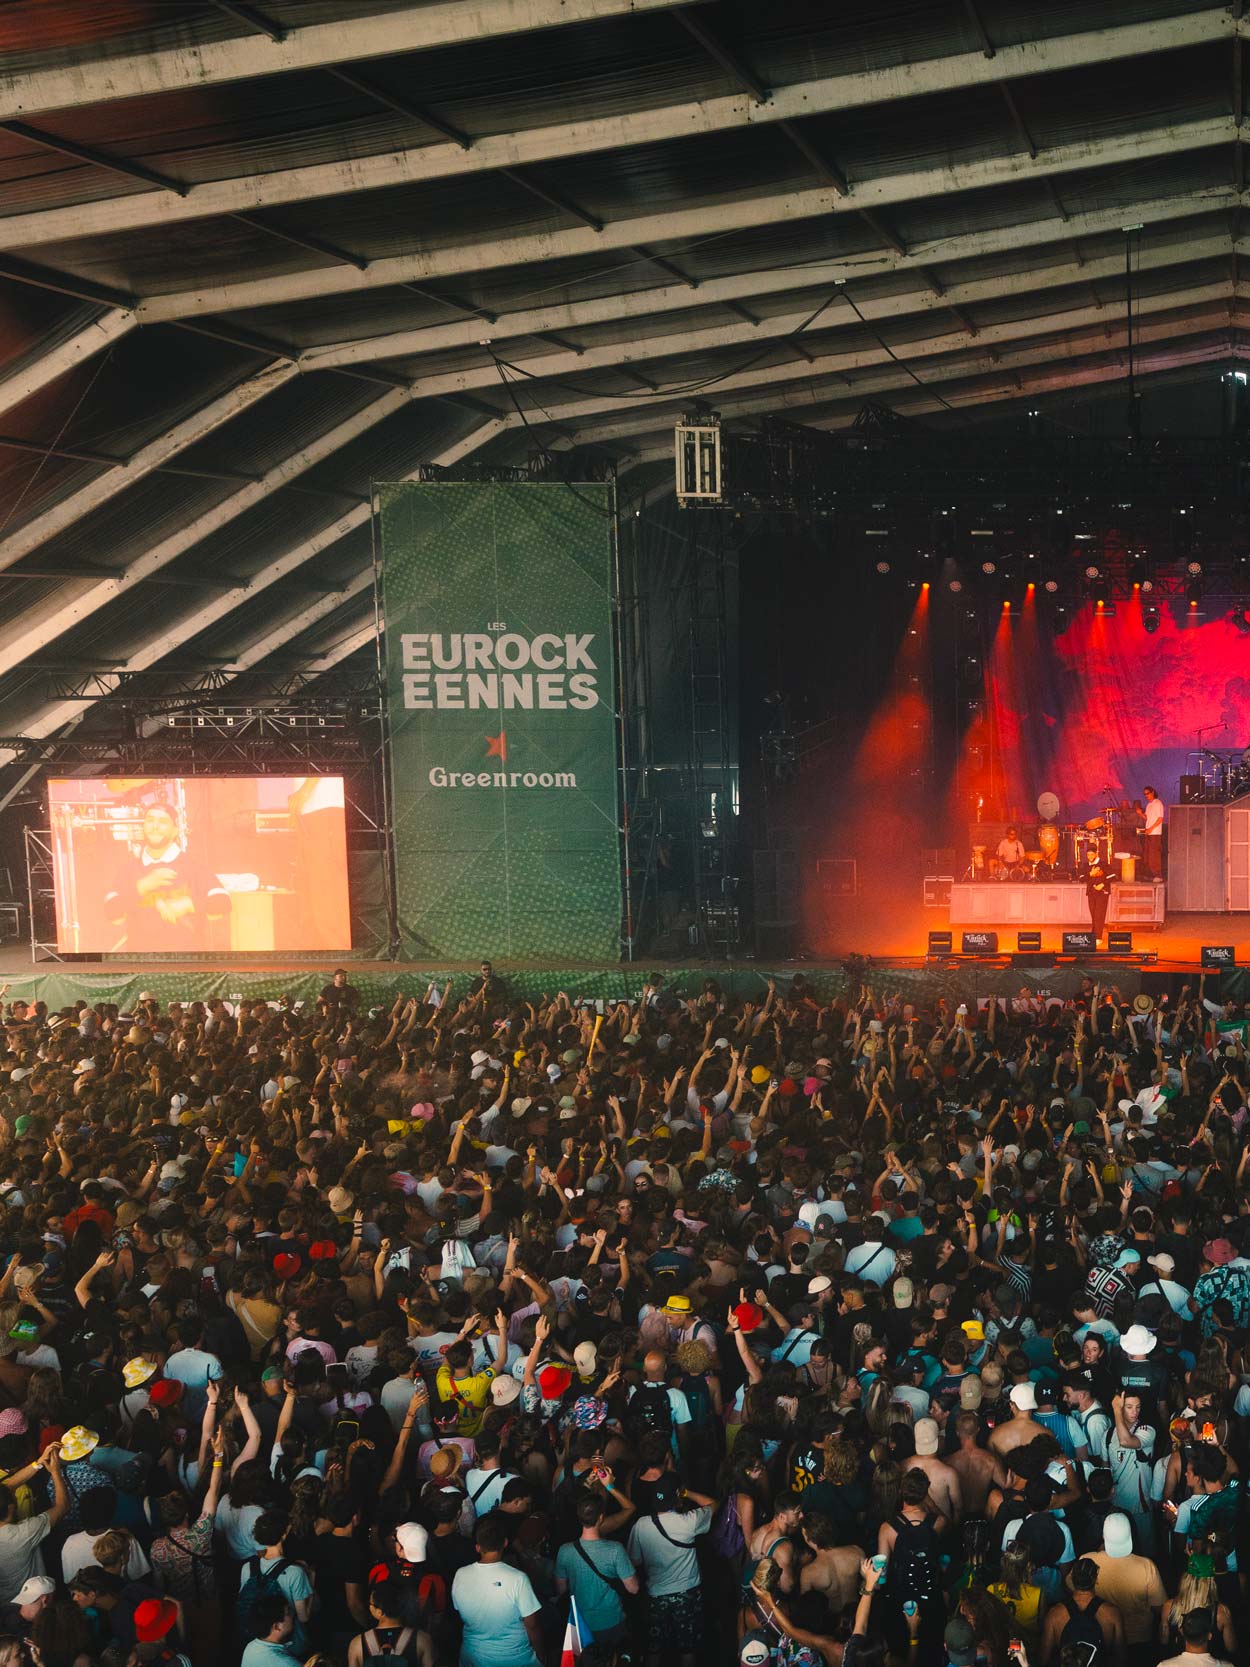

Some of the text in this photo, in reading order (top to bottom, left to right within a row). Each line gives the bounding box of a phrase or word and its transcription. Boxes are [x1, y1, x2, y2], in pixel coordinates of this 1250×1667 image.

[487, 622, 507, 631] LES
[400, 633, 598, 670] EUROCK
[401, 673, 599, 710] EENNES
[428, 767, 577, 788] Greenroom
